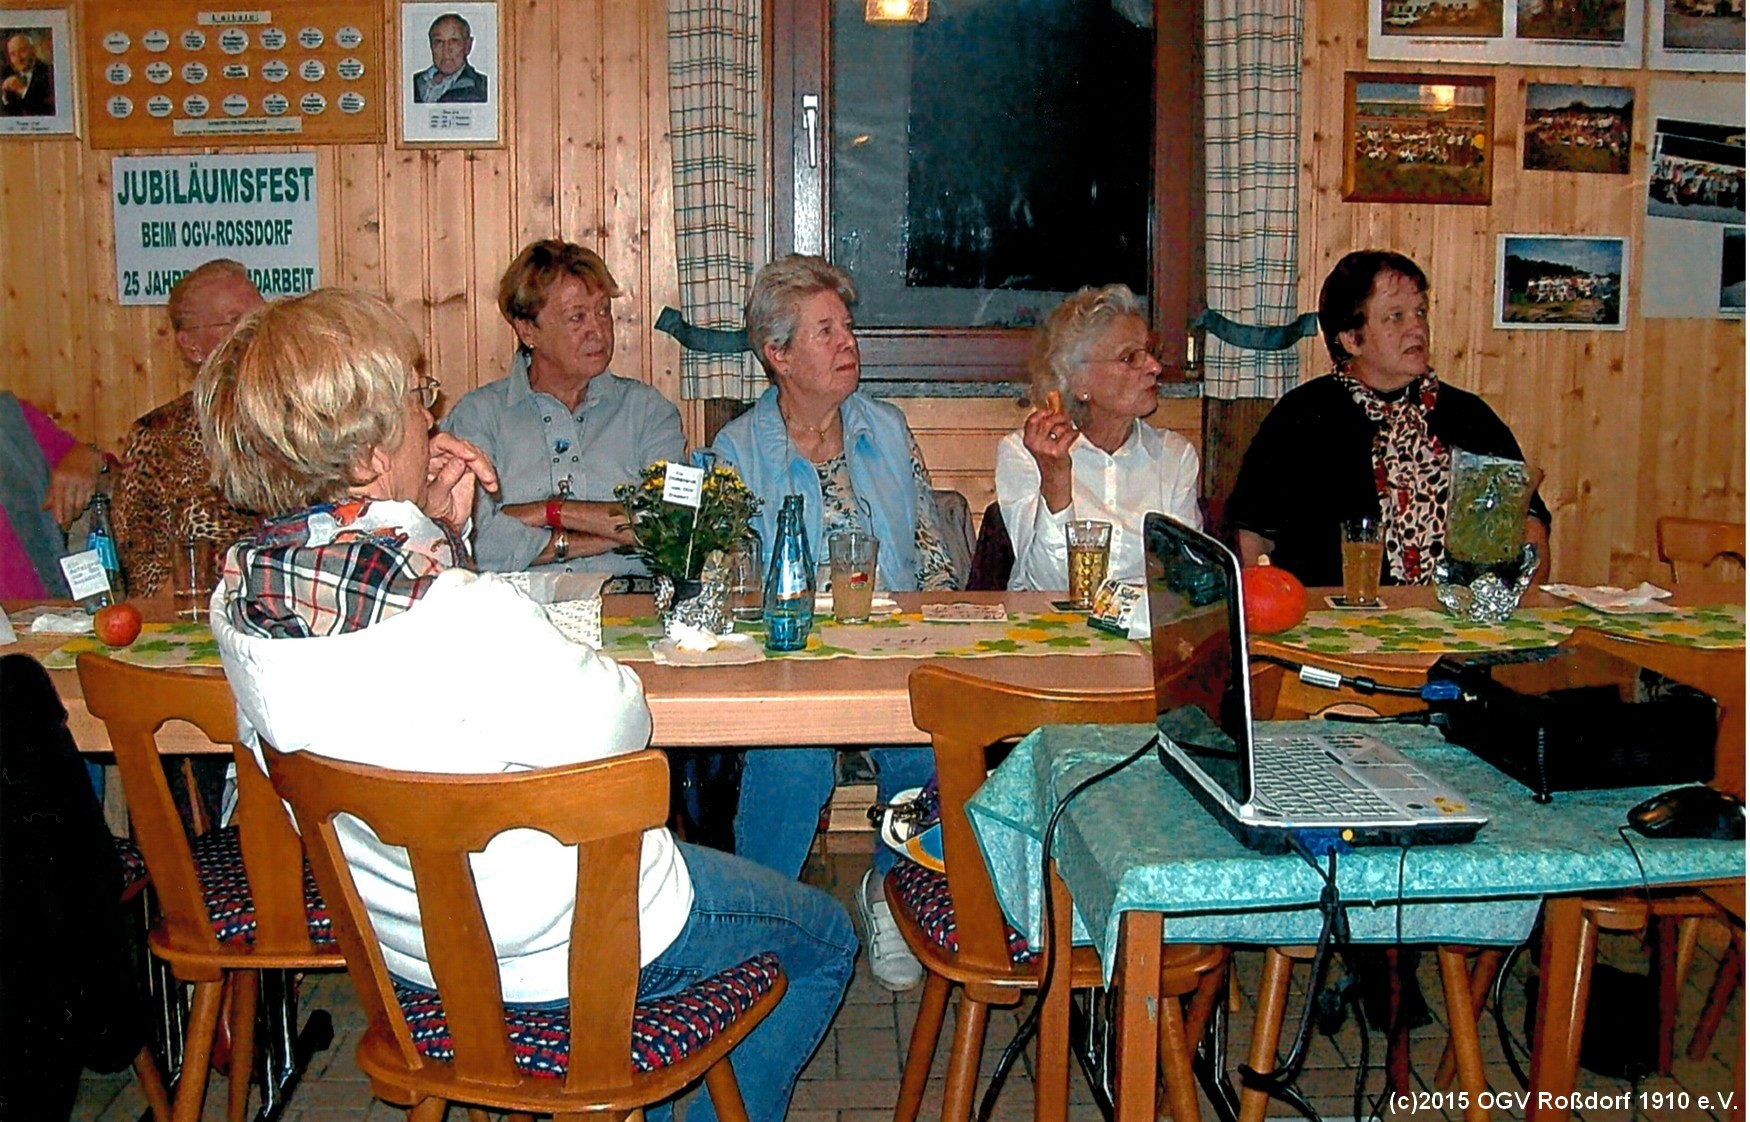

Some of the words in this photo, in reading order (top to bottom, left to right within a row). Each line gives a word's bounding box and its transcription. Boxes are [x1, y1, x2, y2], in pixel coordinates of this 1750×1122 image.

[141, 221, 177, 248] BEIM
[181, 219, 293, 247] OGV-ROSSDORF
[123, 270, 140, 296] 25
